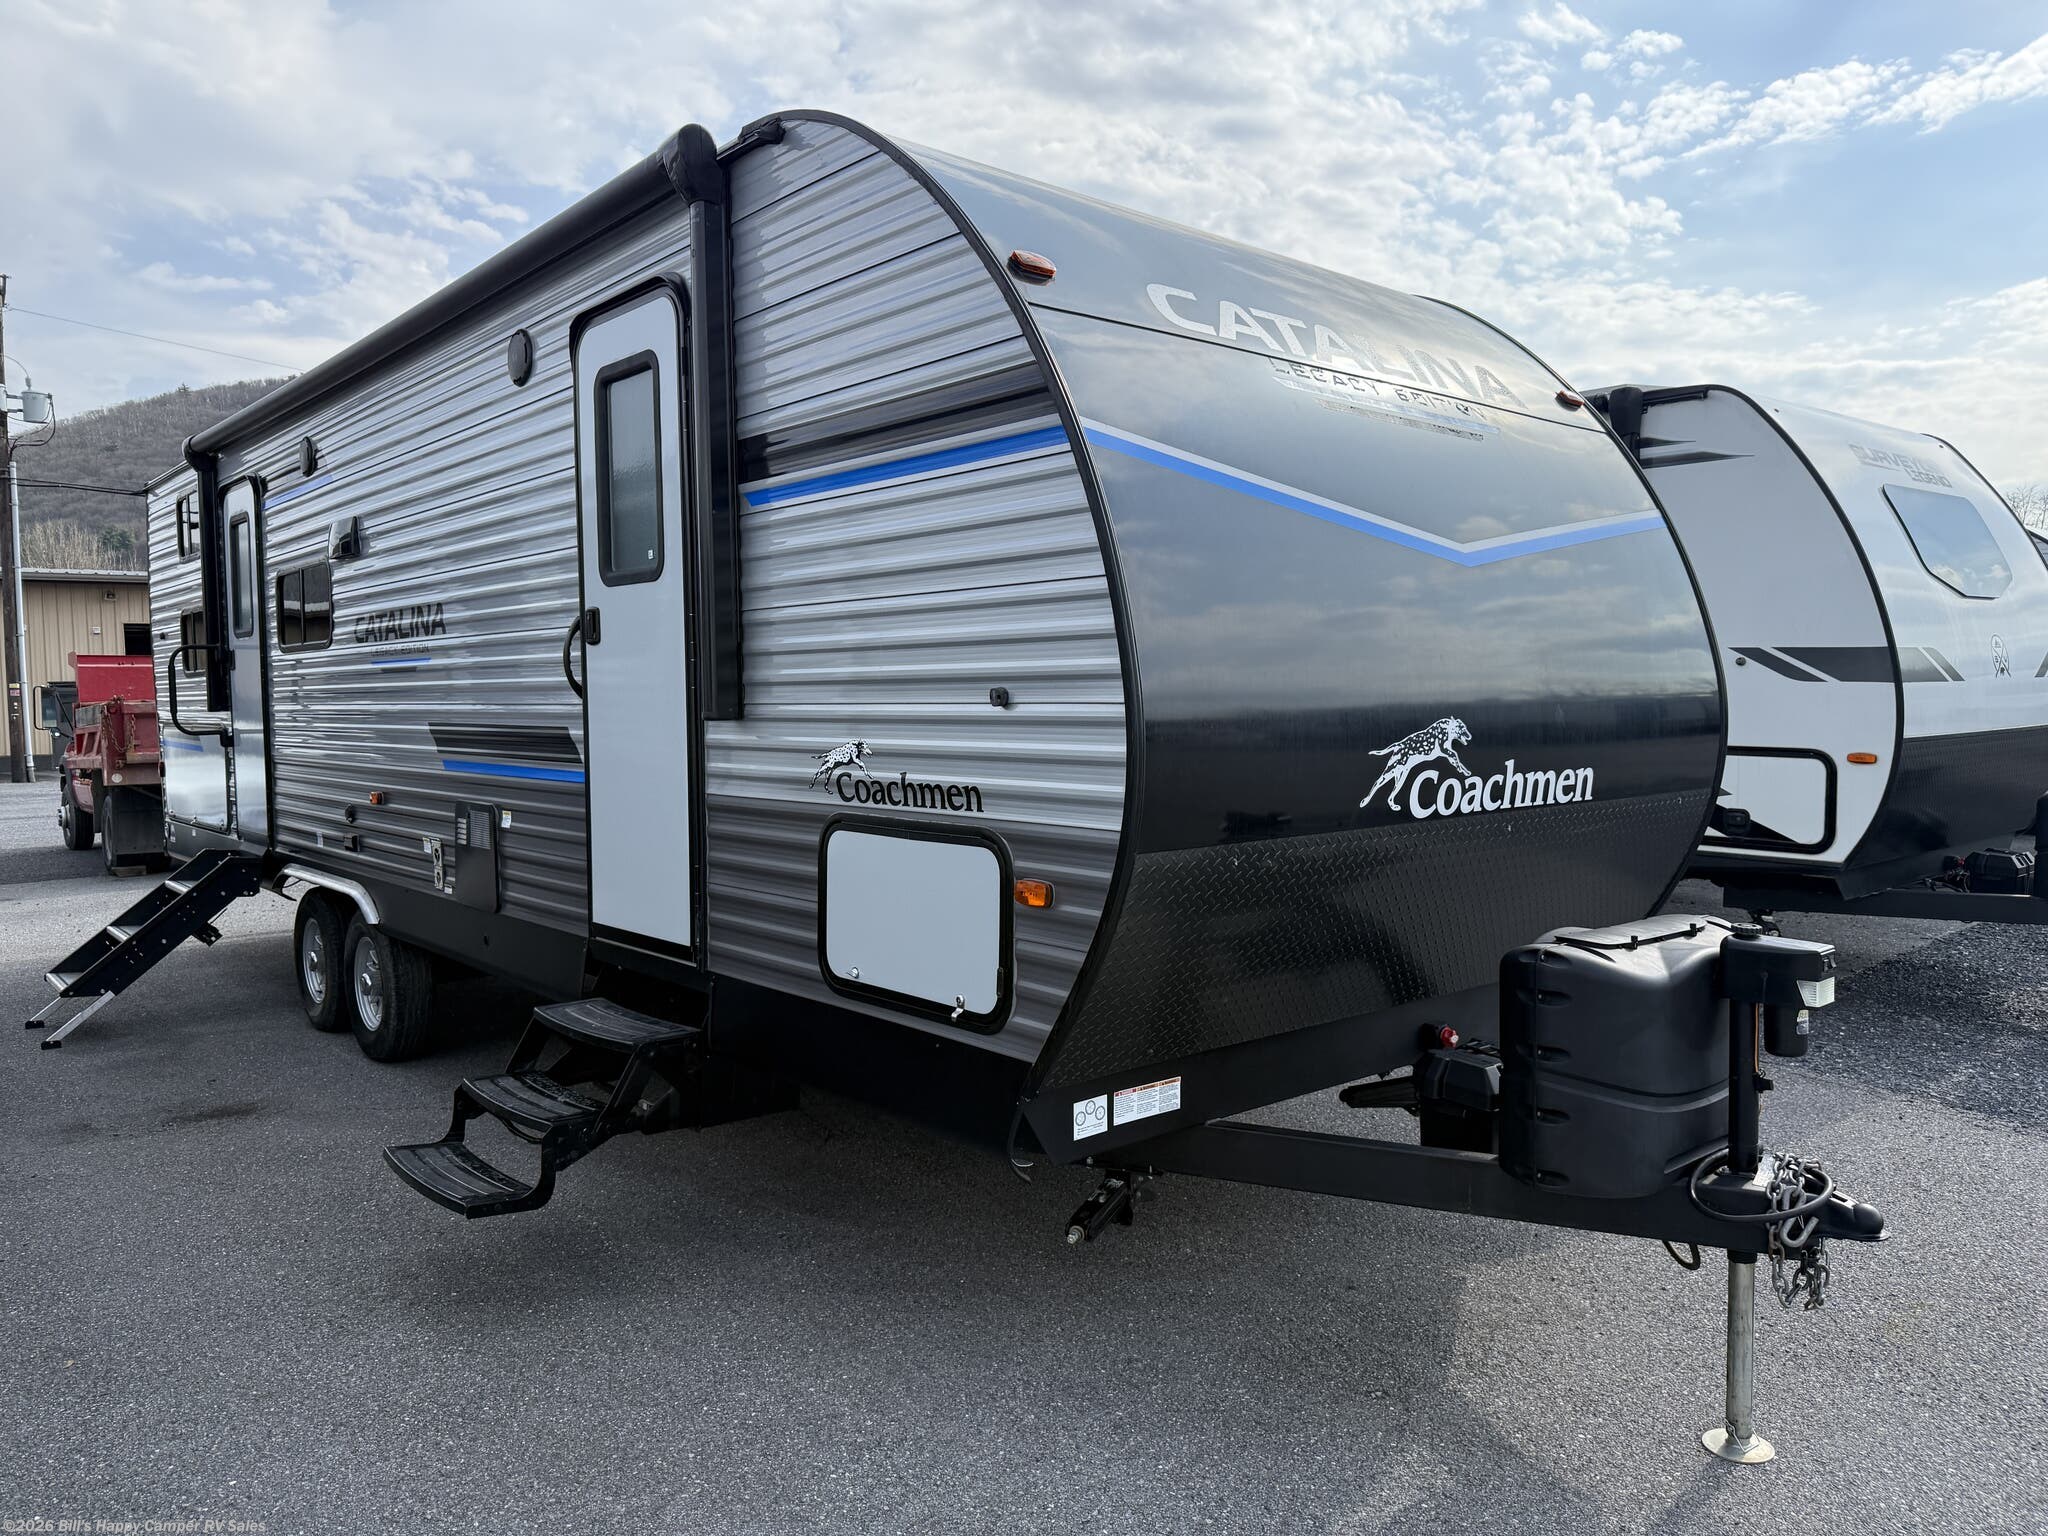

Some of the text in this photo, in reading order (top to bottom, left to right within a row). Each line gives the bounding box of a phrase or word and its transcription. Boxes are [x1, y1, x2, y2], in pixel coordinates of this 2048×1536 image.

[1146, 283, 1528, 409] CATALINA
[1268, 357, 1381, 396] LEGACY
[354, 602, 447, 643] CATALINA
[836, 771, 985, 812] Coachmen
[1409, 758, 1594, 819] Coachmen
